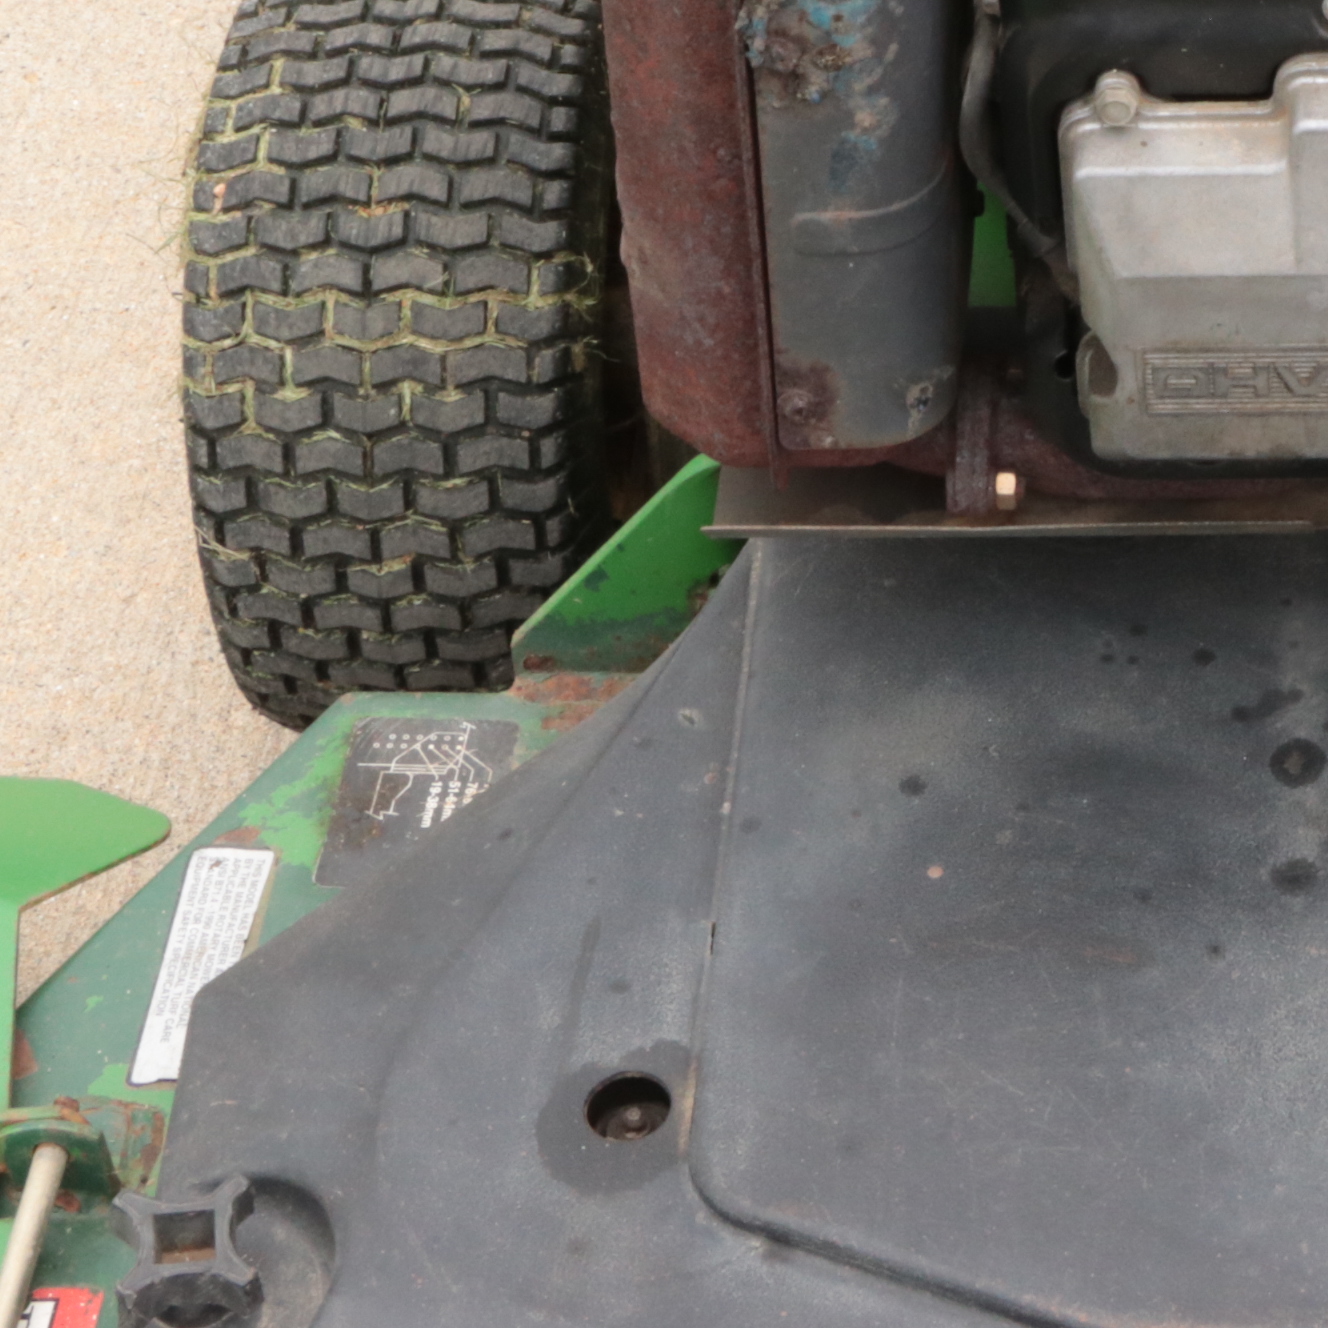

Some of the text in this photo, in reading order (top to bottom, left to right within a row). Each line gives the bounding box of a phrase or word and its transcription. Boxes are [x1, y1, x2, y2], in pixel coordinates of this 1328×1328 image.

[420, 781, 442, 828] 19-38mm
[218, 857, 230, 877] ANSI
[244, 858, 254, 869] BY
[254, 859, 265, 877] THIS
[220, 857, 242, 911] APPLICABLE
[238, 872, 250, 888] THE
[244, 880, 259, 909] MODEL
[193, 907, 205, 924] FOR
[217, 891, 244, 964] MANUFACTURER
[238, 912, 250, 931] HAS
[155, 856, 207, 1016] EQUIPMENT SAFETY SPECIFICATION
[209, 914, 226, 950] ROTARY
[231, 933, 244, 957] BEEN
[175, 927, 199, 987] COMMERCIAL
[190, 932, 209, 979] AMERICAN
[199, 953, 215, 986] MOWE
[168, 992, 181, 1014] TURF
[176, 982, 195, 1028] NATIONAL
[160, 1018, 174, 1042] CARE
